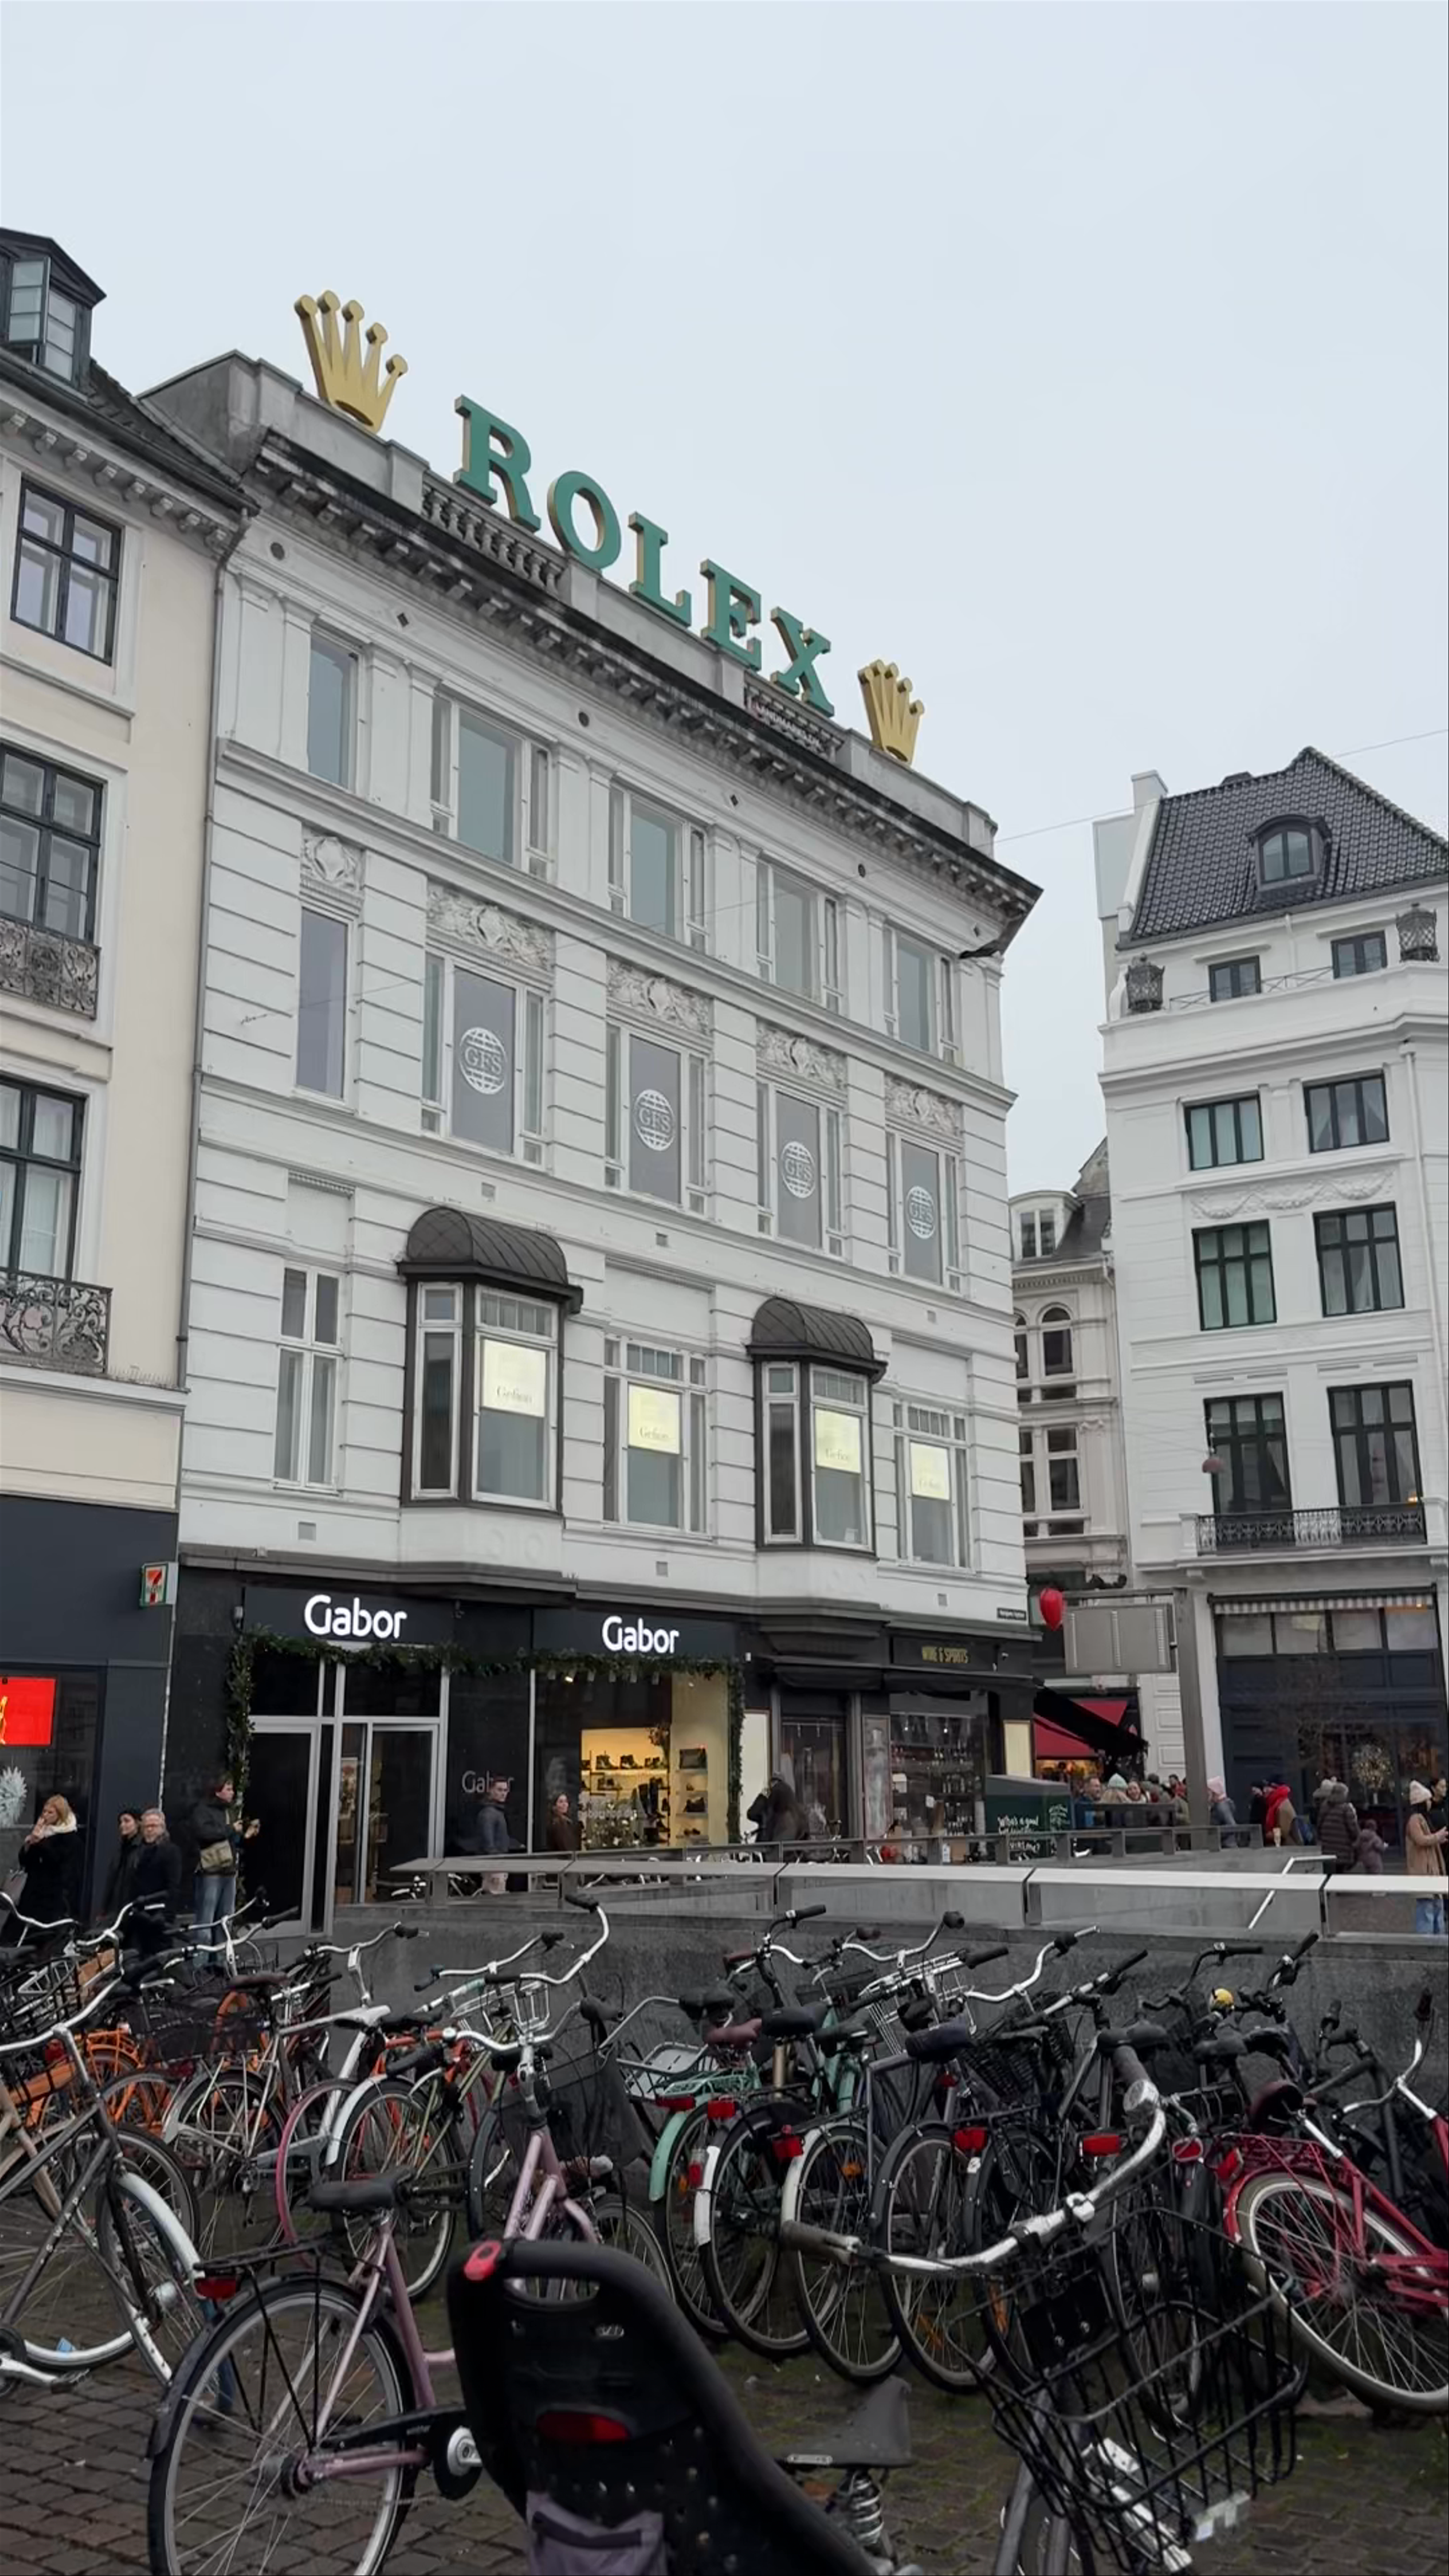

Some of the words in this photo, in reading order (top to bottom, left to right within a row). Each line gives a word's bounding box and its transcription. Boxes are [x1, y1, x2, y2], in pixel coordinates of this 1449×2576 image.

[453, 395, 834, 718] ROLEX
[465, 1046, 502, 1075] GFS
[639, 1107, 672, 1133] GFS
[304, 1594, 408, 1639] Gabor
[602, 1615, 680, 1654] Gabor
